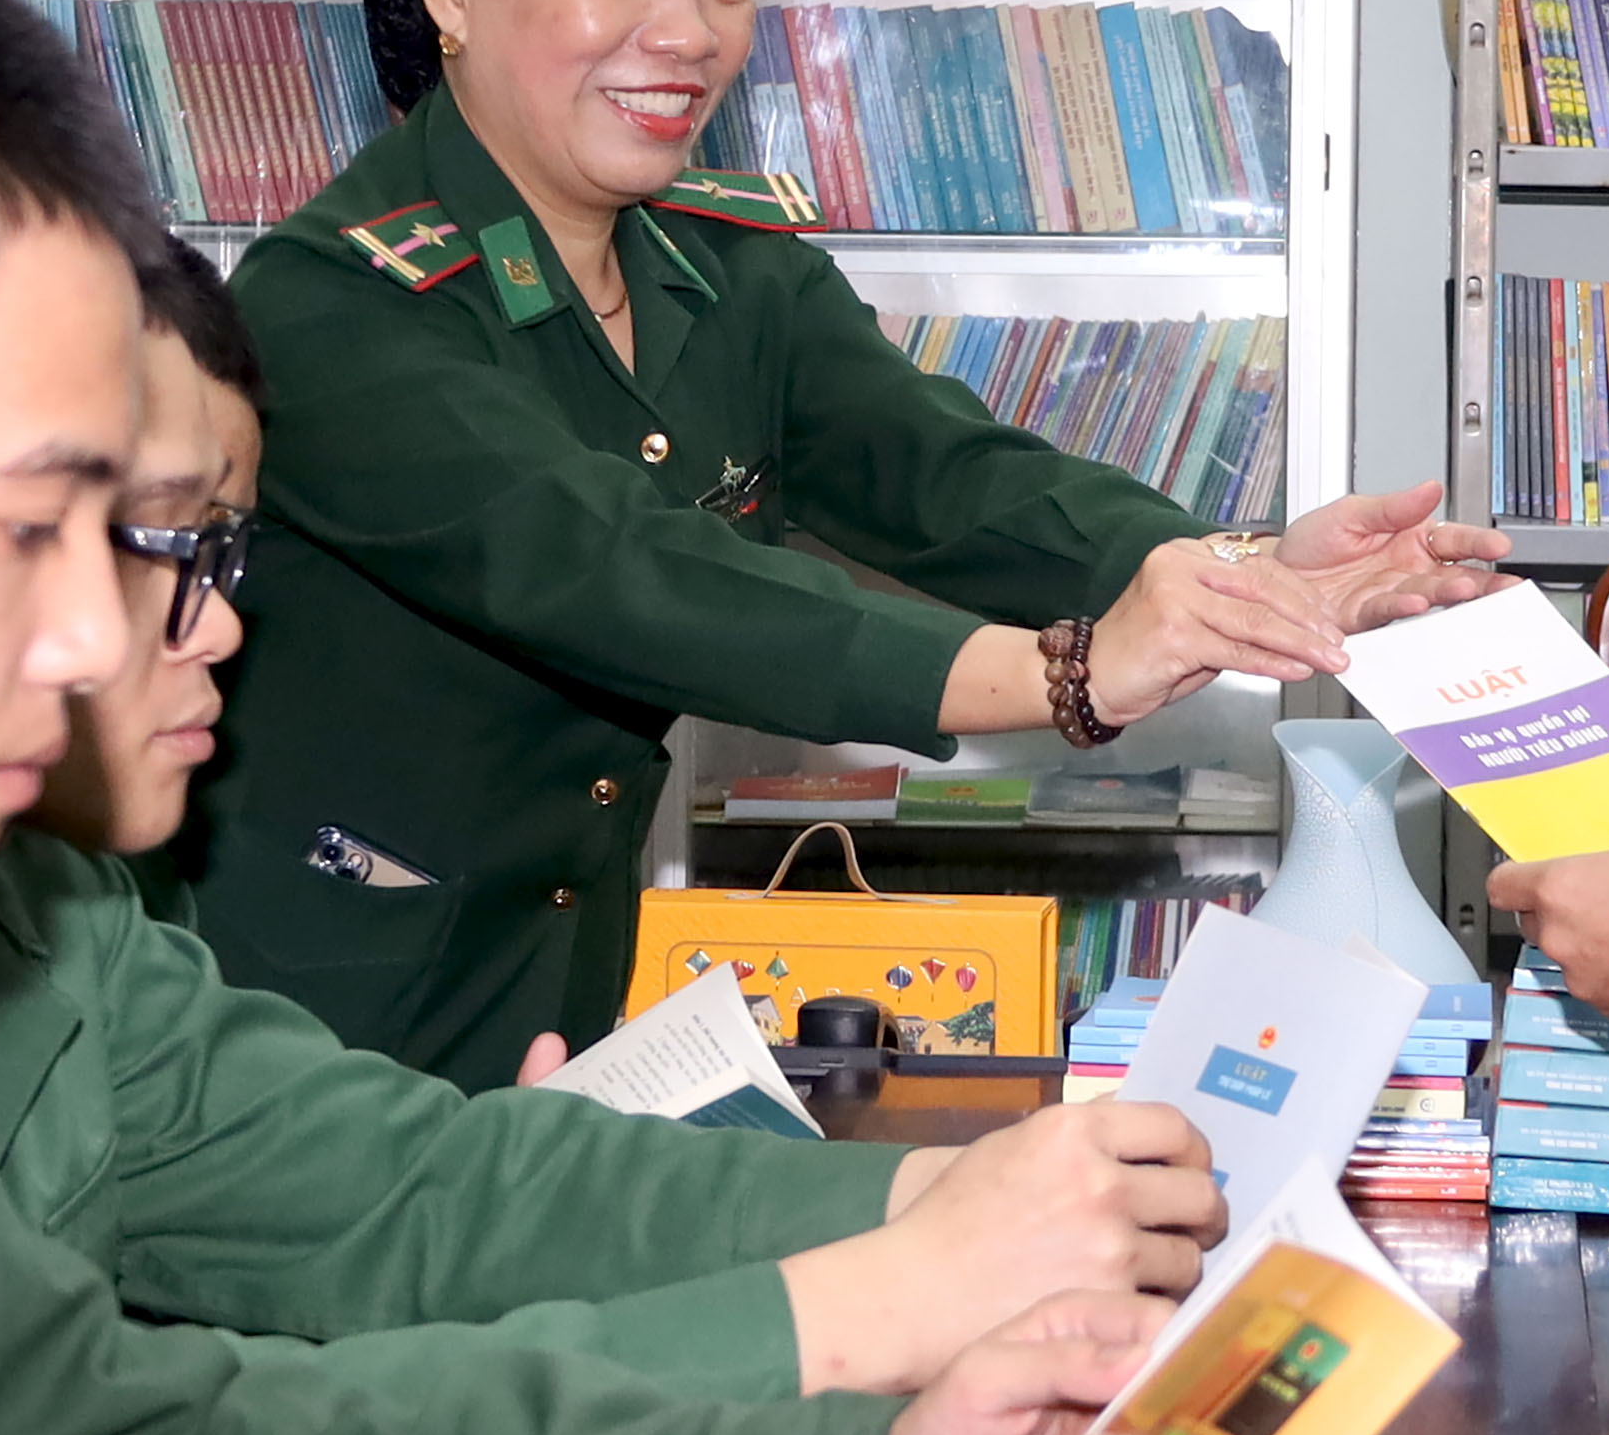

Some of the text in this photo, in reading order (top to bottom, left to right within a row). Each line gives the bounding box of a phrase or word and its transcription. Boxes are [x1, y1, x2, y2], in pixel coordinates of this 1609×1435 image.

[1437, 666, 1528, 704] LUẬT
[1478, 724, 1608, 768] NGƯỜI TIÊU DÙNG
